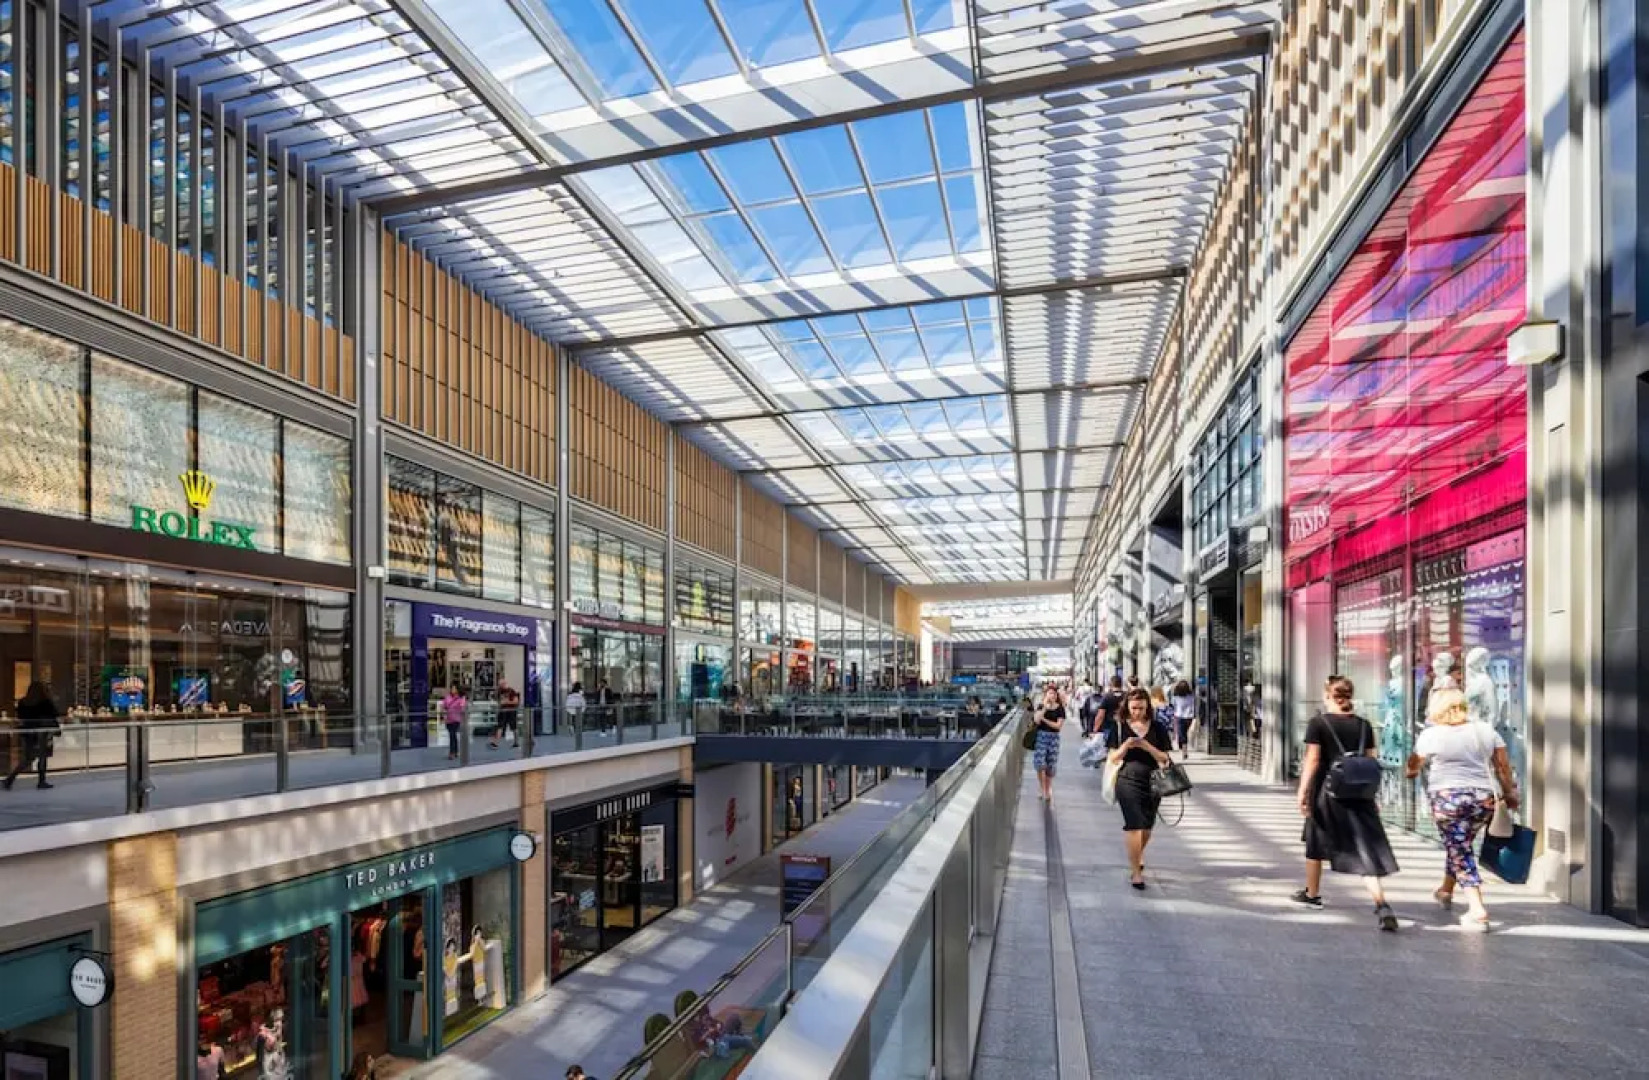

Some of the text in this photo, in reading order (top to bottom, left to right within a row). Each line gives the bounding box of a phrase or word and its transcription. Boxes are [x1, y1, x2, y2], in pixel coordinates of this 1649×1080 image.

[130, 504, 257, 550] ROLEX
[432, 613, 529, 637] The Fragrance Shop
[346, 852, 435, 890] TED BAKER
